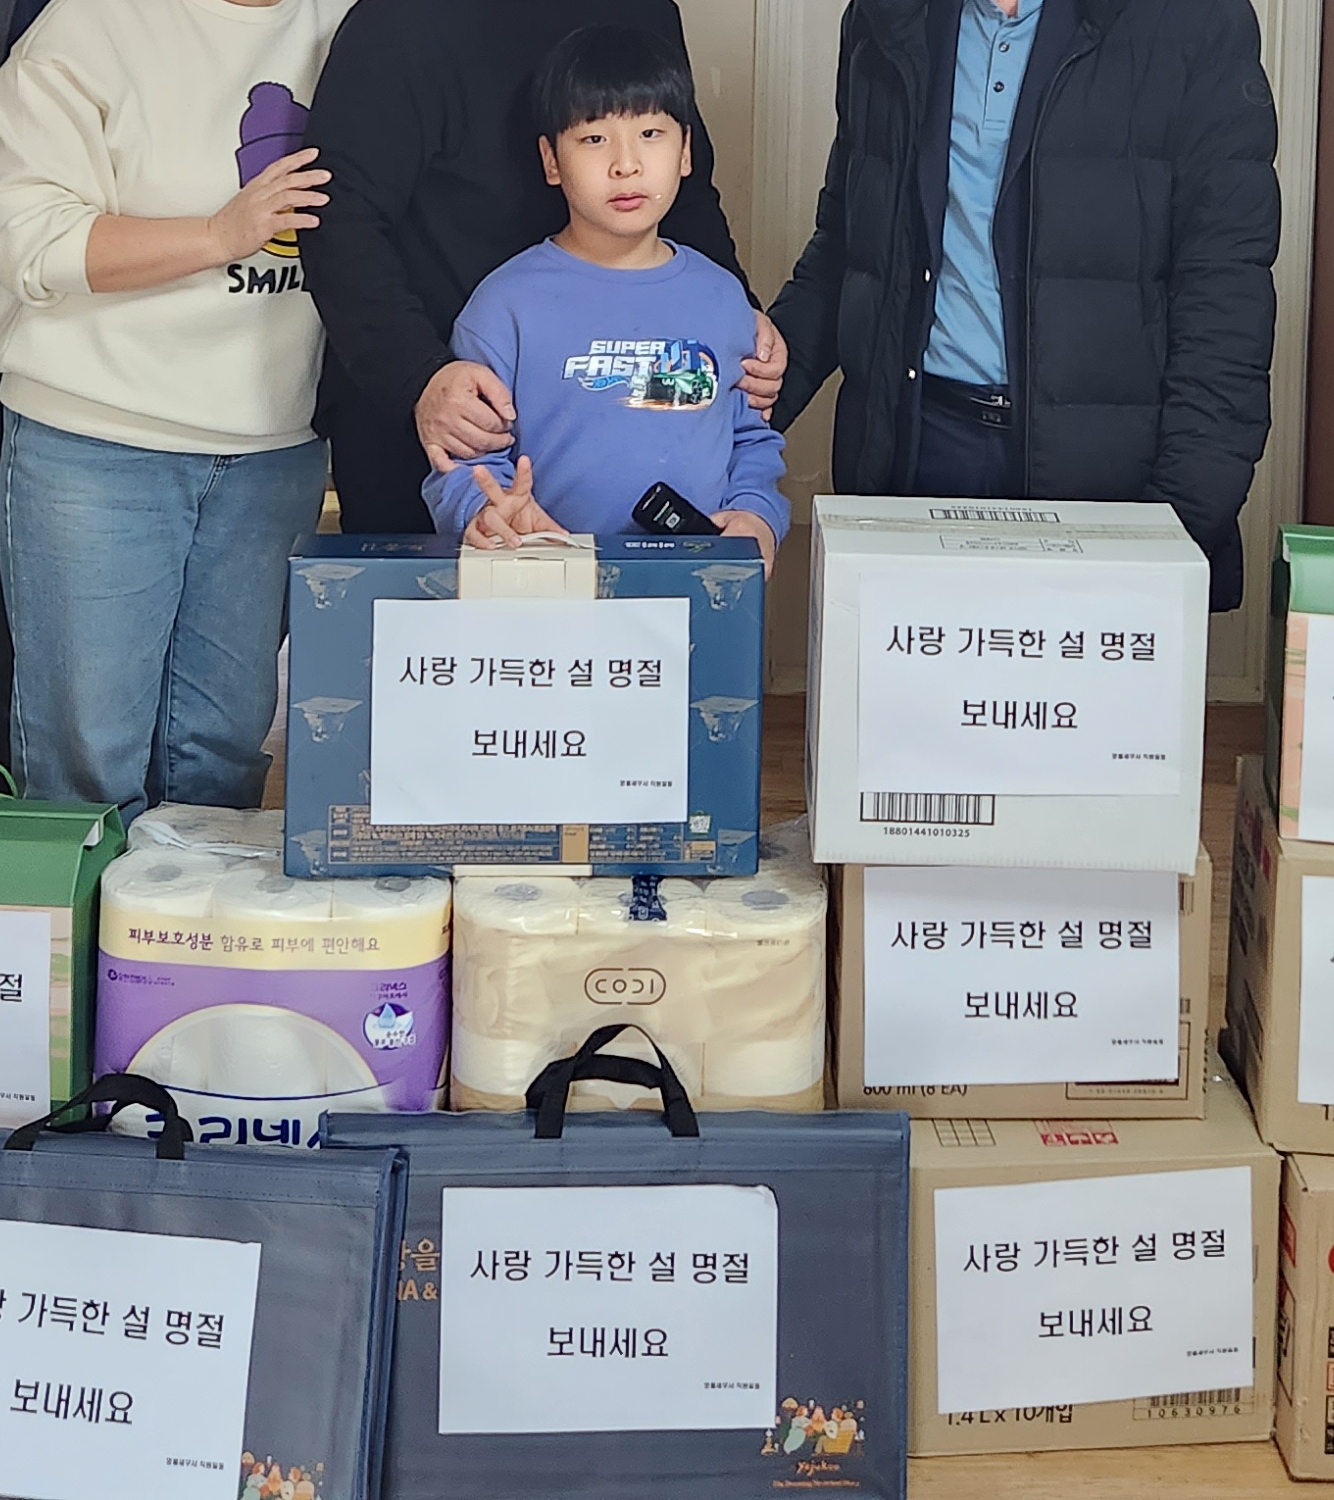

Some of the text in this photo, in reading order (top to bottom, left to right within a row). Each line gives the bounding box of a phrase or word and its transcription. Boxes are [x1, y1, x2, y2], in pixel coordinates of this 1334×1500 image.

[588, 339, 666, 355] SUPER
[563, 354, 657, 380] FAST
[886, 625, 1156, 662] 사랑 가득한 설 명절
[399, 656, 662, 689] 사랑 가득한 설 명절
[960, 699, 1079, 731] 보내세요
[471, 729, 587, 759] 보내세요
[127, 927, 380, 955] 피부보호성분 함유로 피부에 편안해요
[890, 920, 1152, 951] 사랑 가득한 설 명절
[964, 990, 1079, 1020] 보내세요
[469, 1249, 749, 1285] 사랑 가득한 설 명절
[963, 1228, 1226, 1274] 사랑 가득한 설 명절
[422, 1282, 438, 1300] &
[17, 1291, 110, 1336] 가득한
[122, 1304, 150, 1341] 설
[164, 1309, 225, 1350] 명절
[1038, 1305, 1154, 1338] 보내세요
[546, 1326, 669, 1359] 보내세요
[9, 1378, 134, 1425] 보내세요
